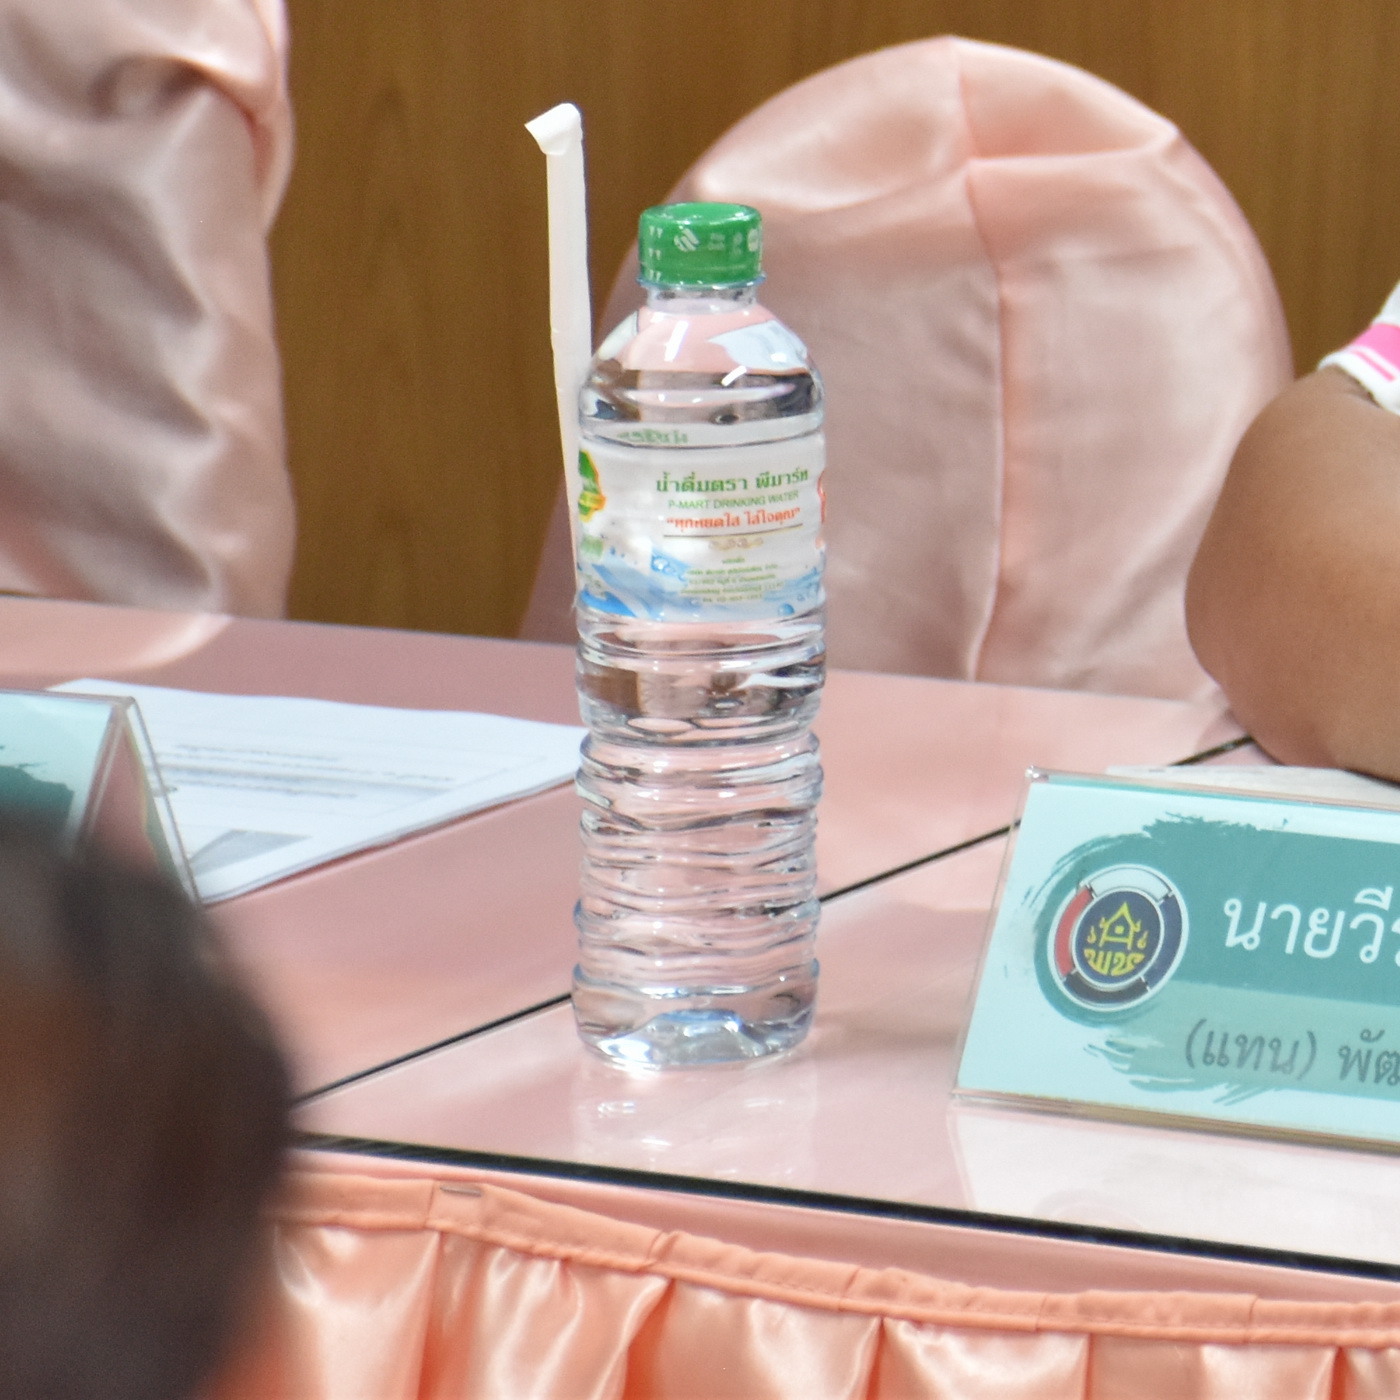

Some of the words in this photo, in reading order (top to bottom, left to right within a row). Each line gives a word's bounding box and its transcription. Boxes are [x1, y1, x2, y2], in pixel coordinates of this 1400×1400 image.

[656, 470, 748, 492] น้ำดื่มตรา
[668, 499, 709, 509] P-MART
[713, 495, 766, 509] DRINKING
[768, 490, 799, 504] WATER
[1184, 1017, 1318, 1082] (แทน)
